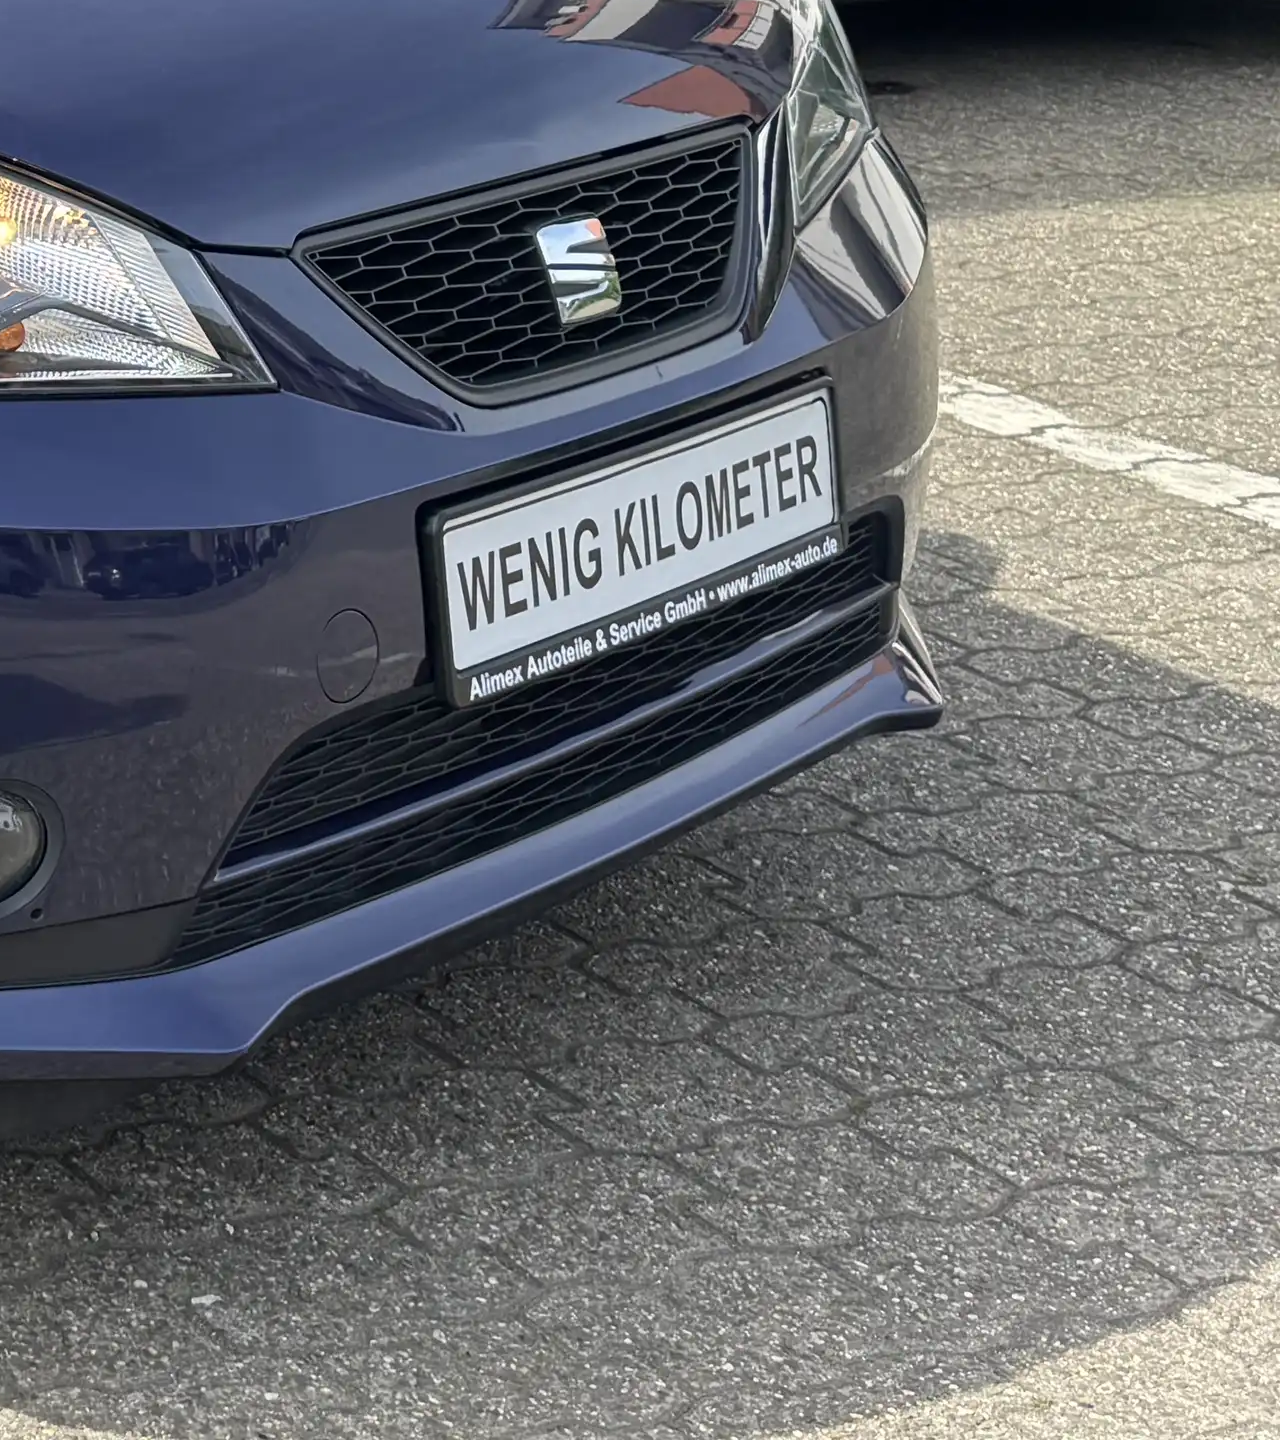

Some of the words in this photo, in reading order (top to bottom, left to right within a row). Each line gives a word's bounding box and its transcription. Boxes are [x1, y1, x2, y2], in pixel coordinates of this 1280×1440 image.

[456, 517, 603, 632] WENIG
[613, 435, 823, 578] KILOMETER
[469, 669, 524, 702] Alimex
[527, 636, 593, 680] Autoteile
[595, 628, 608, 652] &
[609, 610, 662, 645] Service
[664, 587, 708, 625] GmbH
[716, 535, 838, 603] www.alimex-auto.de
